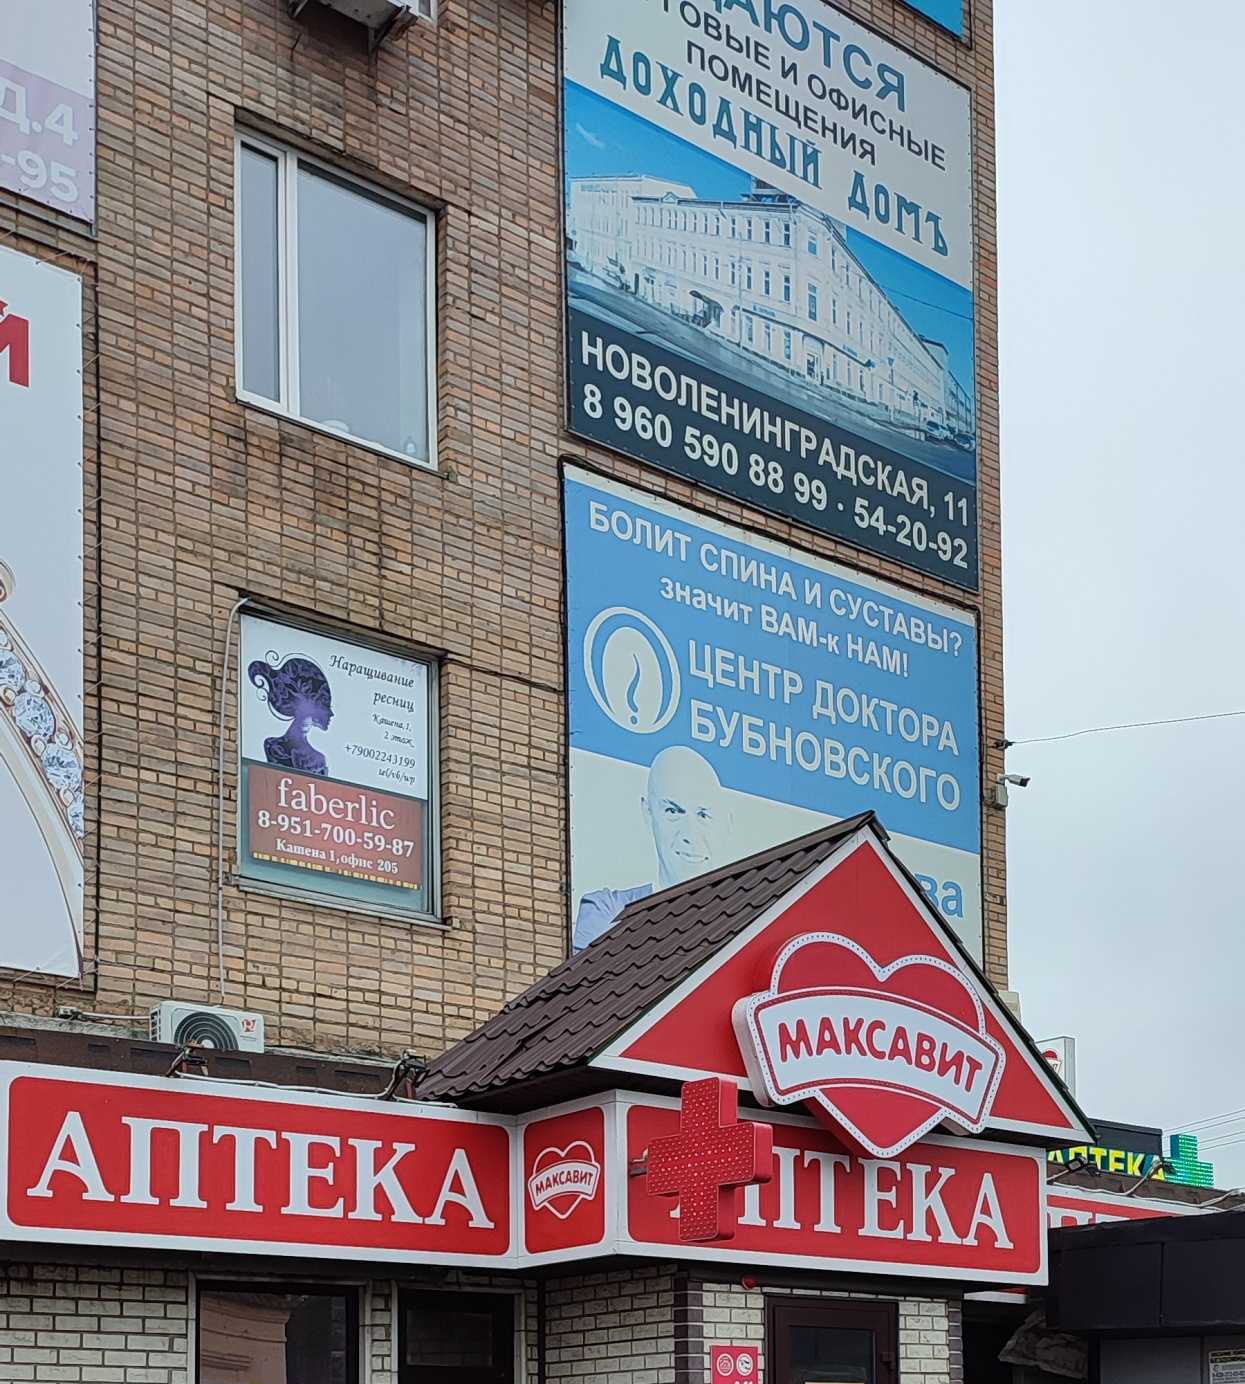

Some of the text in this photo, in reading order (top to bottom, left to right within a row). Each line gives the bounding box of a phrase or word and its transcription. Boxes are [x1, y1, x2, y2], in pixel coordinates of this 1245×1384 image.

[663, 0, 946, 171] ОВЫЕ И ОФИСНЫЕ
[687, 40, 876, 166] ПОМЕЩЕНИЯ
[713, 0, 905, 112] АЮТСЯ
[600, 35, 949, 257] ДОХОДНЫЙ ДОМЪ
[582, 330, 968, 526] НОВОЛЕНИНГРАДСКАЯ, 11
[583, 383, 968, 569] 8 960 590 88 99 54-20-92
[589, 500, 962, 657] БОЛИТ СПИНА И СУСТАВЫ?
[660, 576, 909, 678] значит ВАМ-к НАМ!
[329, 655, 414, 688] Наращивание
[373, 692, 414, 712] ресниц
[688, 639, 960, 756] ЦЕНТР ДОКТОРА
[384, 731, 390, 740] 2
[690, 699, 961, 811] БУБНОВСКОГО
[258, 810, 414, 858] 8-951-700-59-87
[277, 778, 395, 830] faberlic
[377, 858, 399, 874] 205
[779, 1016, 983, 1094] МАКСАВИТ
[26, 1111, 495, 1229] АПТЕКА
[536, 1169, 593, 1197] МАКСАВИТ
[669, 1145, 1014, 1249] ПТЕКА
